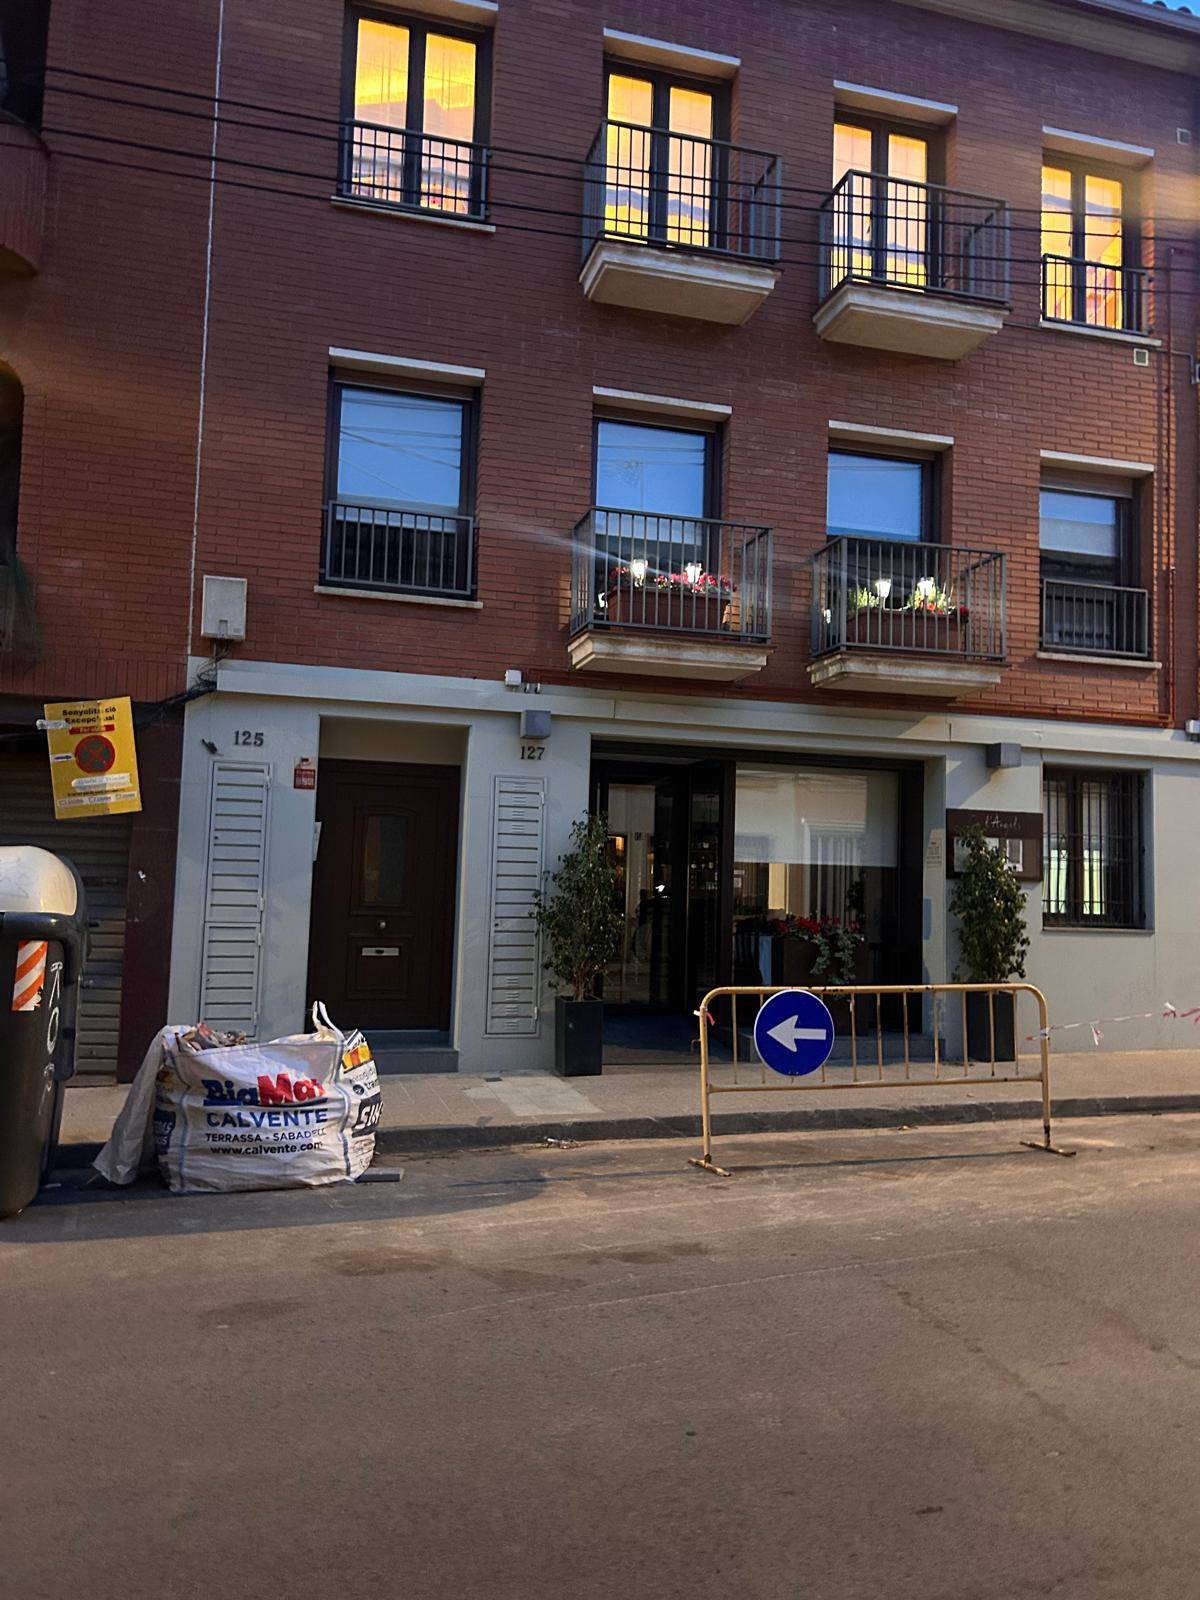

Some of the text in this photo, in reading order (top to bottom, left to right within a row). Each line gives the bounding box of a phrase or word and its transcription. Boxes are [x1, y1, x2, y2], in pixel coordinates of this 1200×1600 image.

[234, 730, 264, 747] 125
[520, 745, 545, 760] 127
[206, 1108, 328, 1128] CALVENTE
[205, 1132, 262, 1143] TERRASSA
[210, 1141, 323, 1155] www.calvente.com
